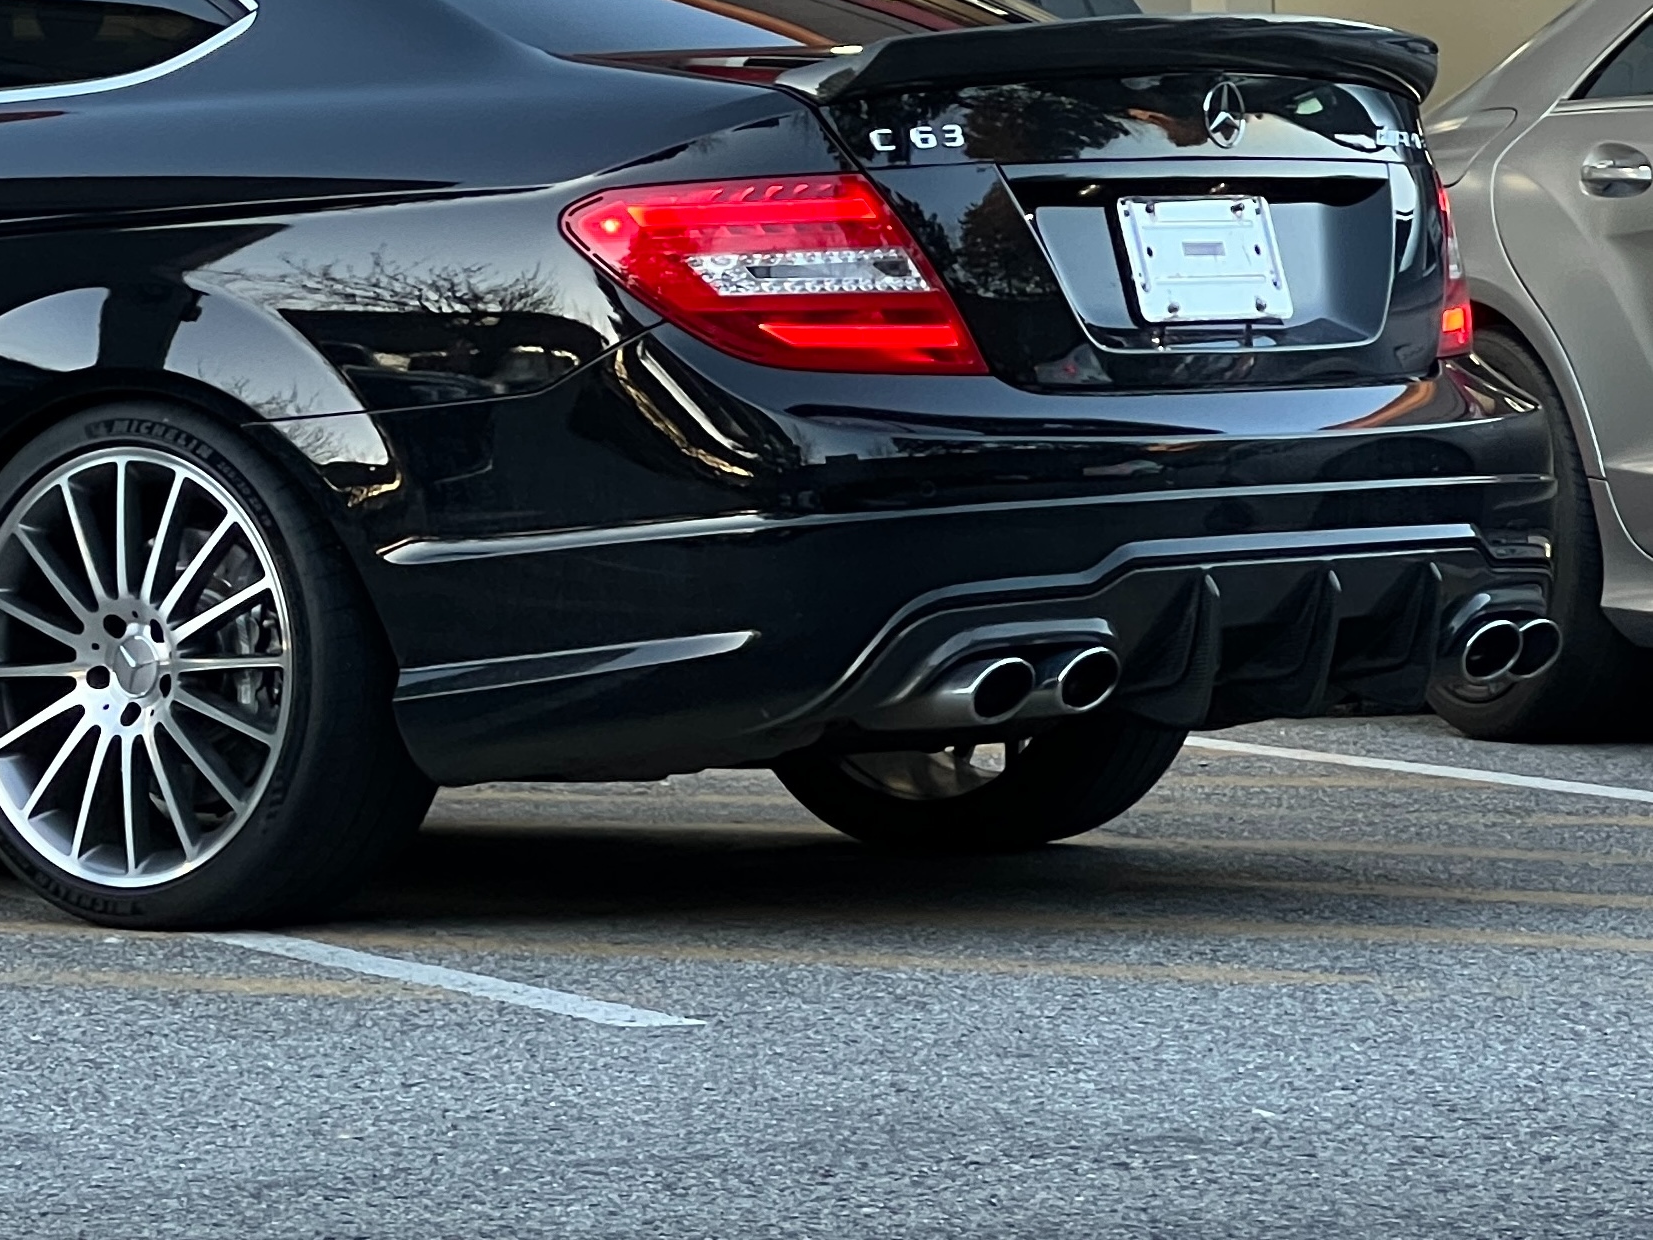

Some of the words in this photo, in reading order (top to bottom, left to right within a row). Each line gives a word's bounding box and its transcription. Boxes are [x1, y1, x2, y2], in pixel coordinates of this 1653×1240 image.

[869, 128, 896, 151] C
[909, 124, 965, 149] 63
[109, 418, 215, 460] MICHELIN
